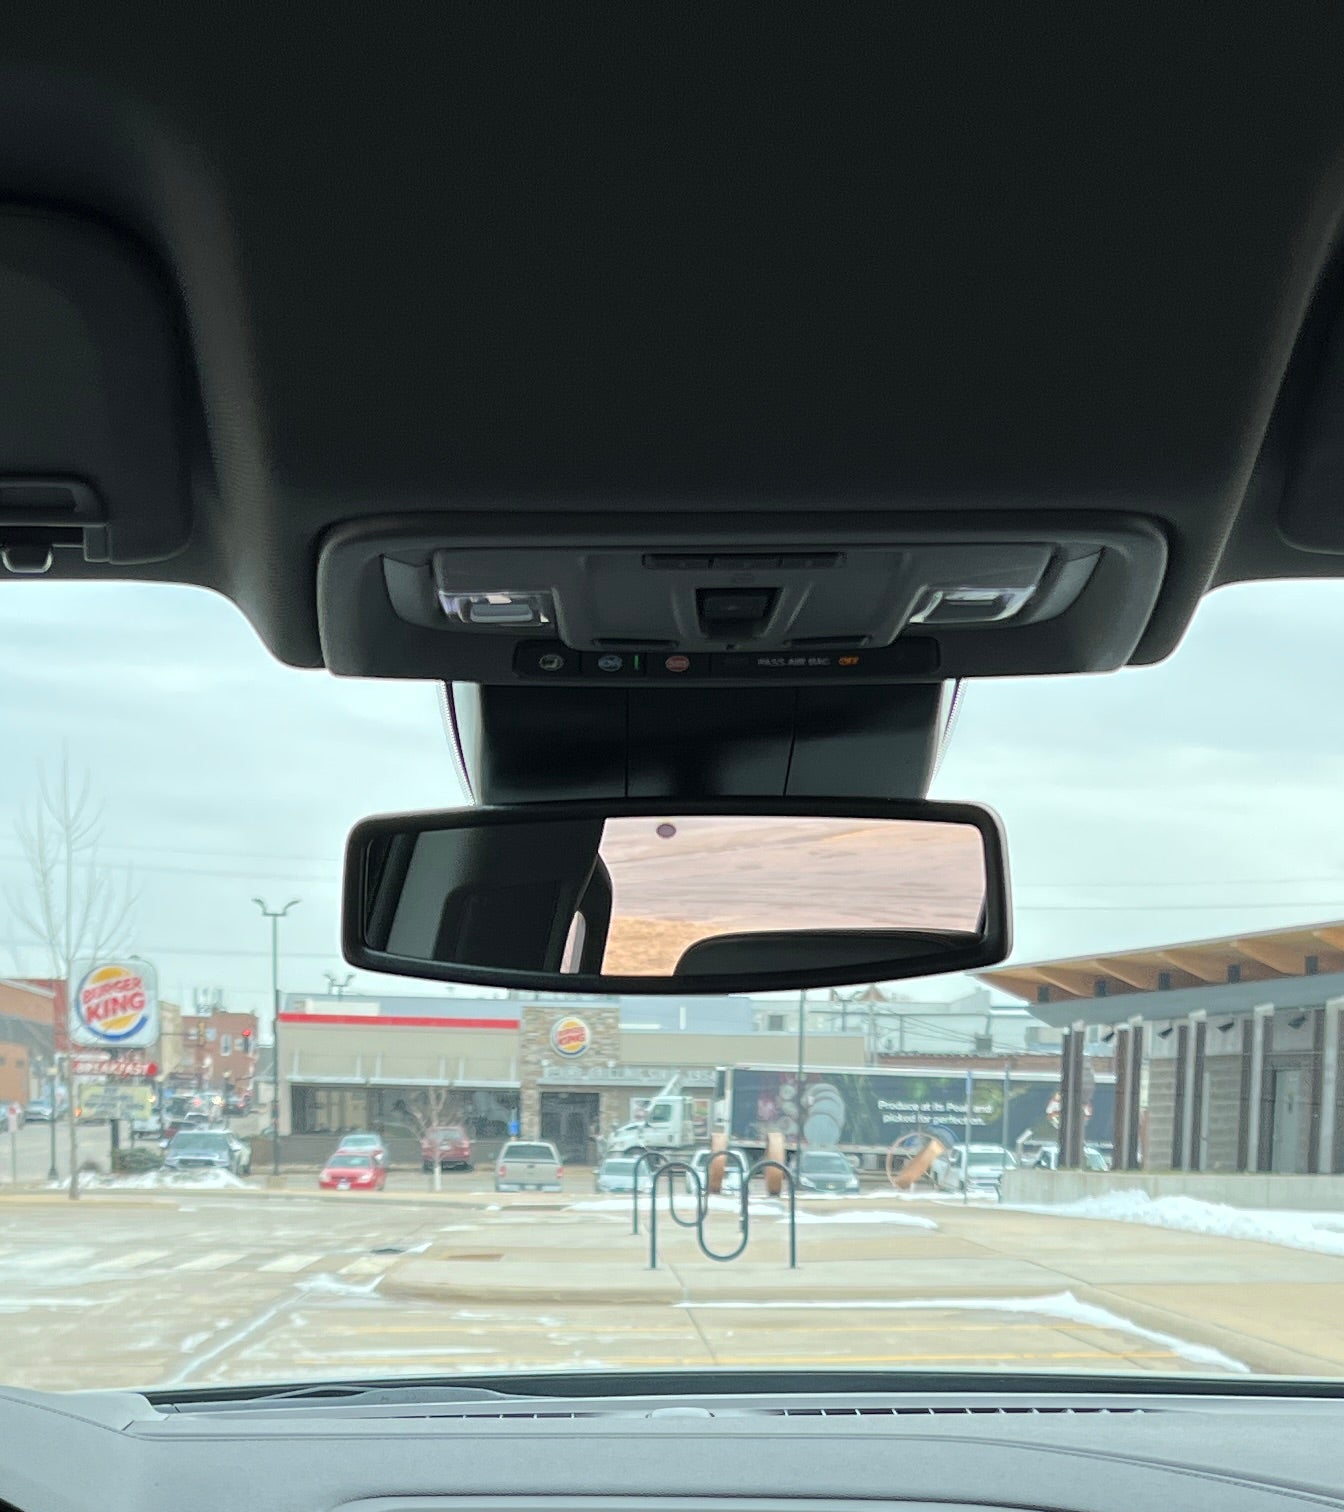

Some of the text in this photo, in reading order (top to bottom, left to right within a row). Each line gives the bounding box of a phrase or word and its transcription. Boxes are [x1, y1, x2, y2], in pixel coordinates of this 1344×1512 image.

[82, 976, 143, 1004] BURGER
[85, 991, 146, 1025] KING
[877, 1100, 919, 1111] Produce
[972, 1103, 993, 1114] and
[882, 1113, 917, 1124] picked
[917, 1113, 931, 1124] for
